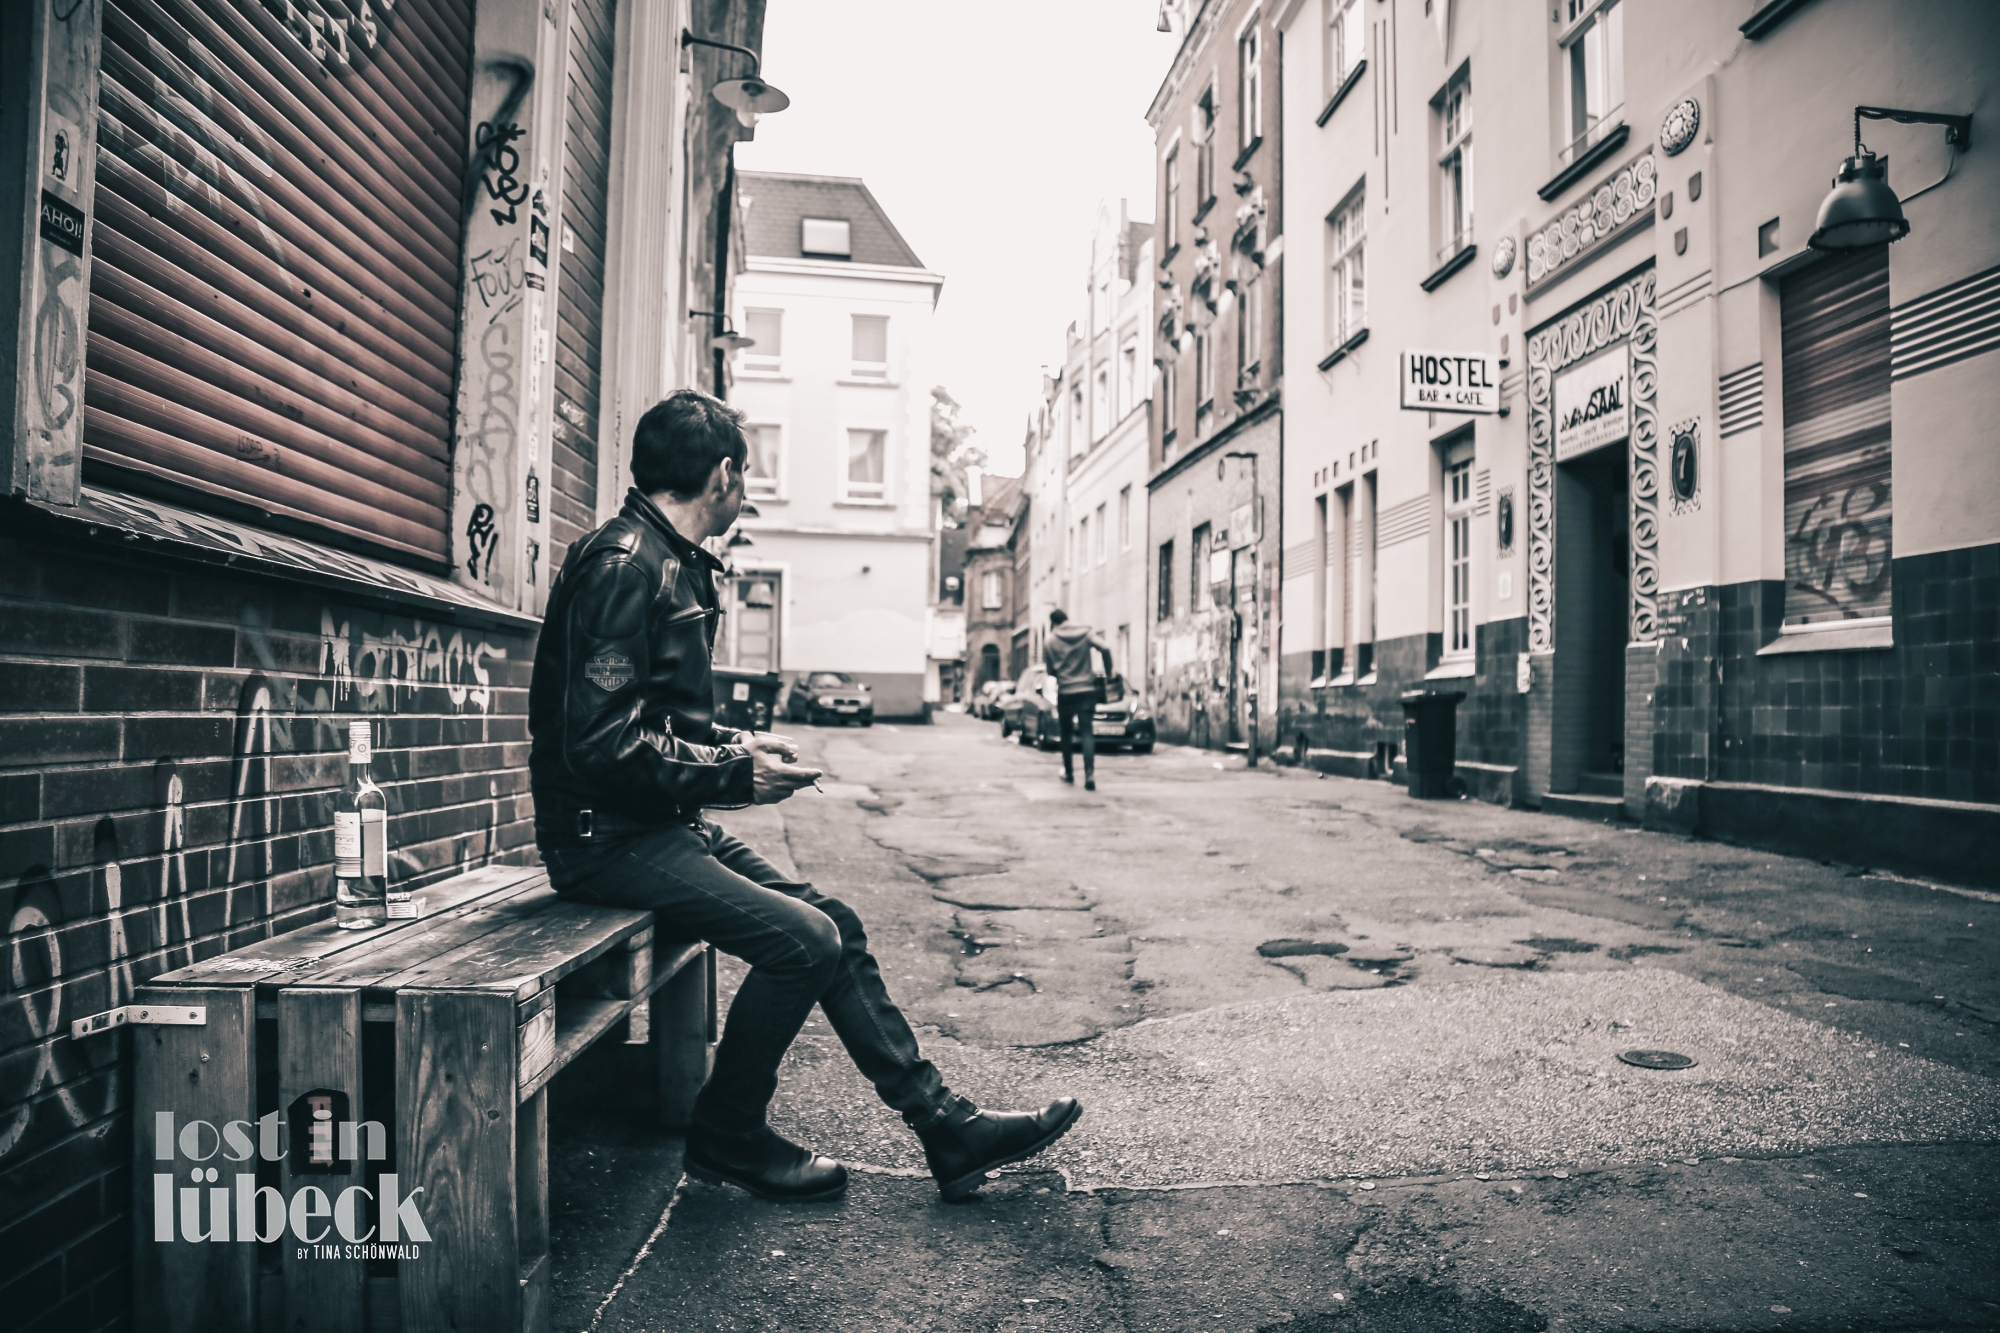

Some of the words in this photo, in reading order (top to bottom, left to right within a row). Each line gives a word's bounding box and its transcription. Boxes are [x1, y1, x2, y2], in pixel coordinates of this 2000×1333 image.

[41, 204, 83, 239] AHOI!
[1411, 354, 1493, 388] HOSTEL
[1419, 389, 1439, 402] BAR
[1457, 391, 1484, 405] CAFE
[1677, 448, 1689, 480] 7
